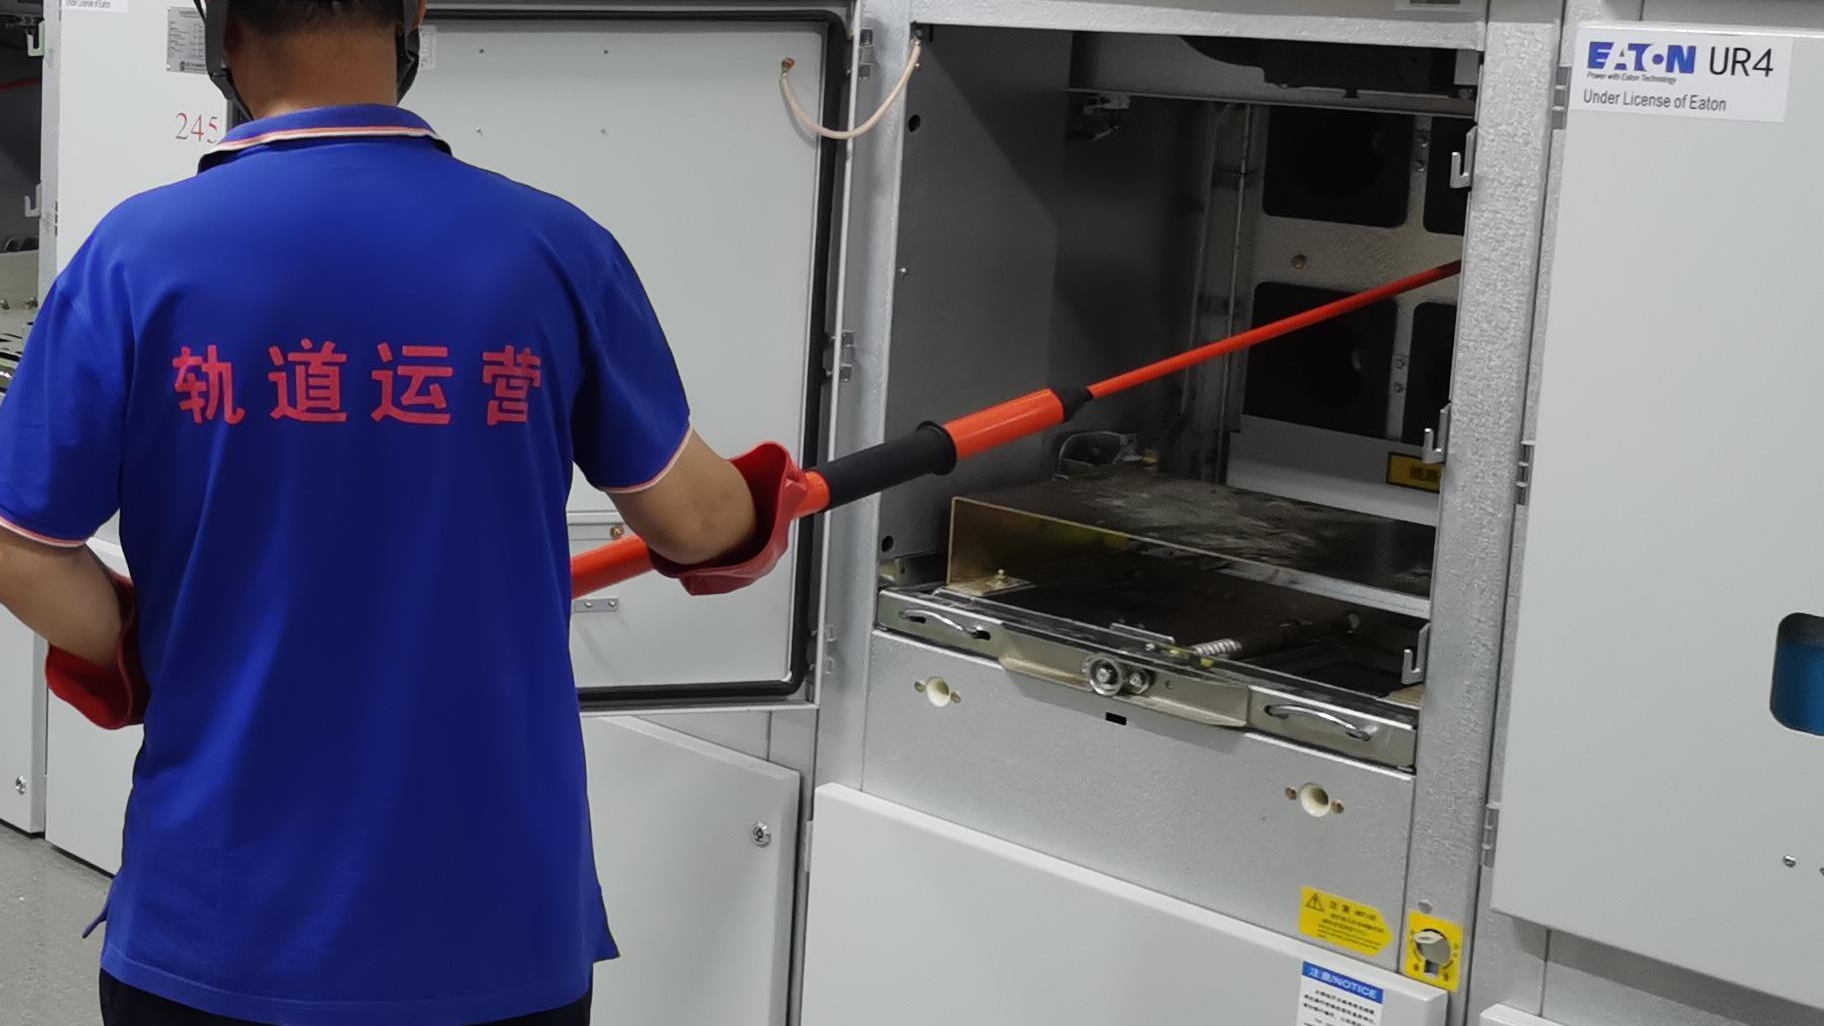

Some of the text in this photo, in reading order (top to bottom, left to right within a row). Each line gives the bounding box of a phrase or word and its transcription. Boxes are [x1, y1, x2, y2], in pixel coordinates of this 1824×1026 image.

[1587, 41, 1774, 78] EATON UR4
[1583, 88, 1727, 113] Under License of Eaton
[175, 112, 219, 144] 245
[172, 338, 542, 426] 轨道运营
